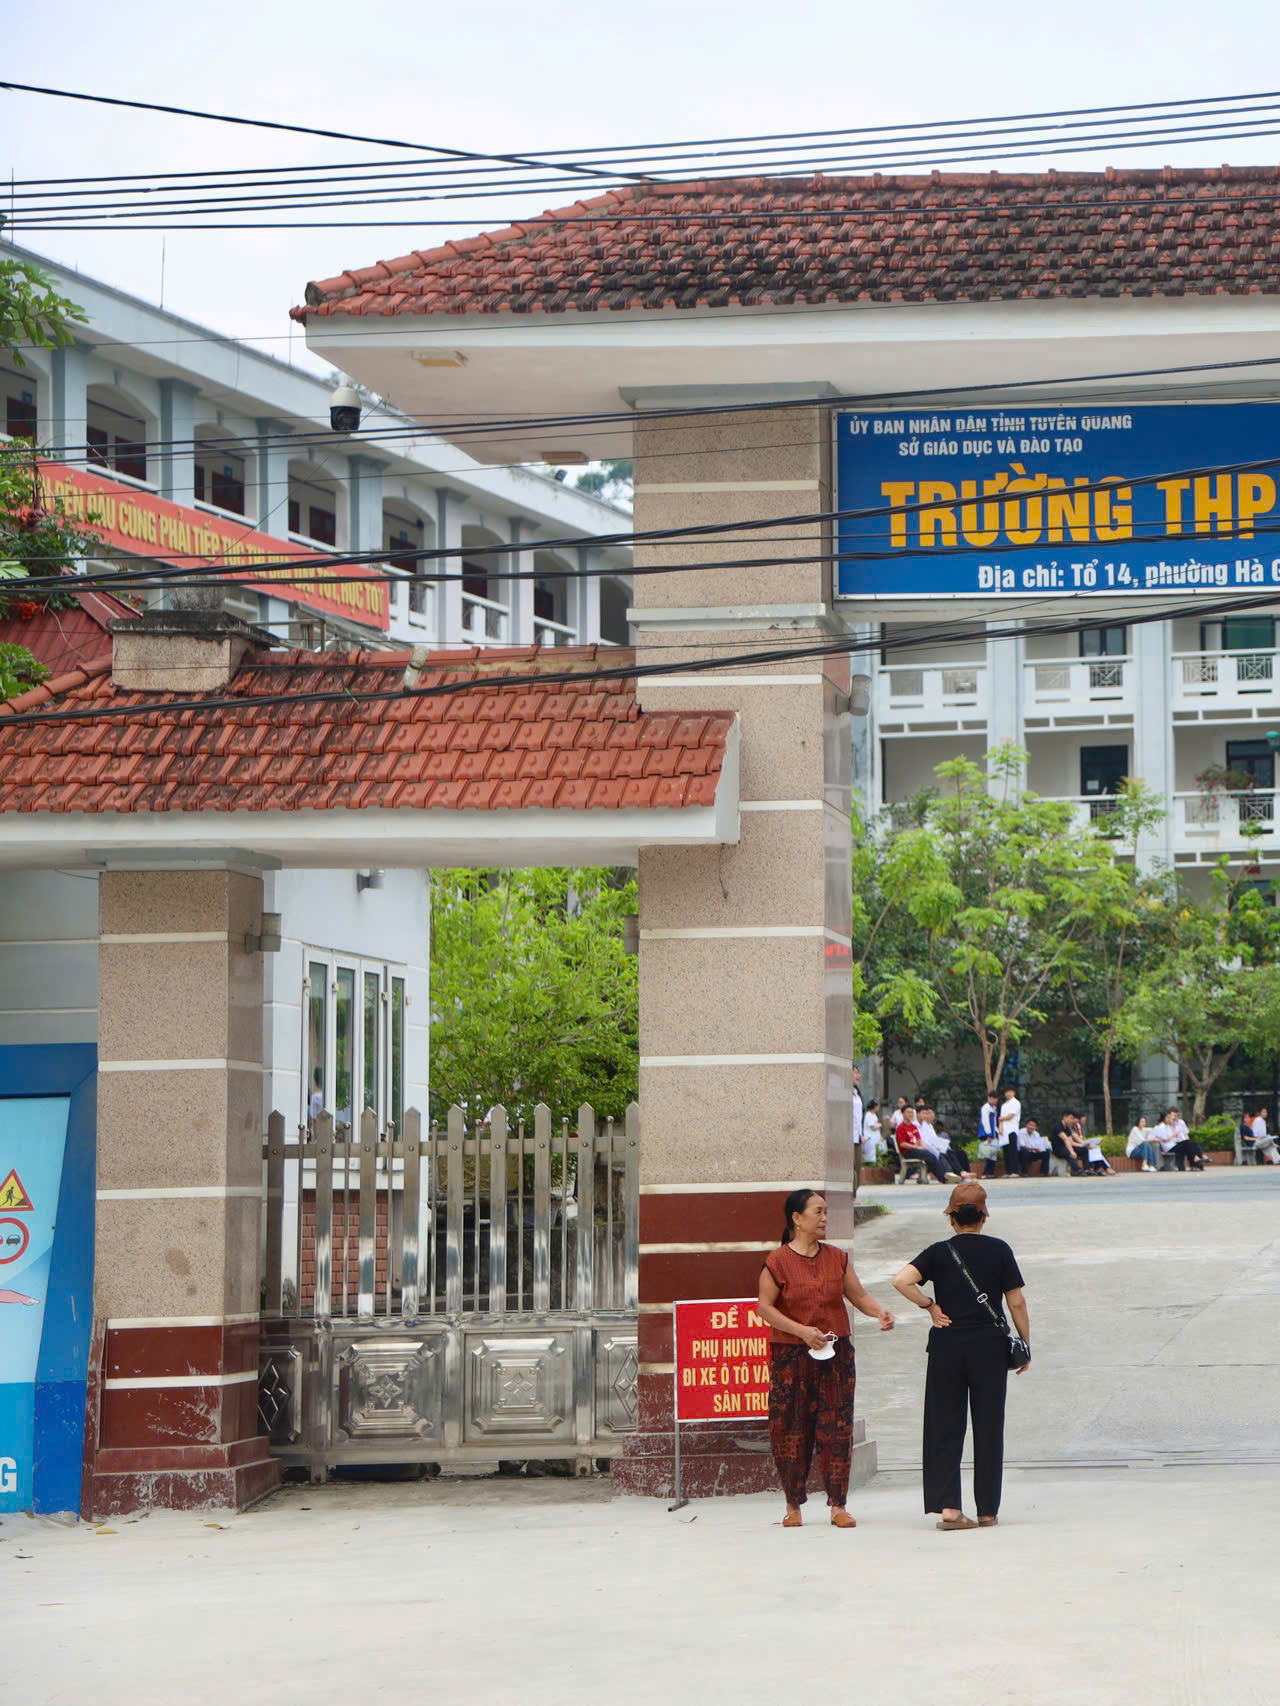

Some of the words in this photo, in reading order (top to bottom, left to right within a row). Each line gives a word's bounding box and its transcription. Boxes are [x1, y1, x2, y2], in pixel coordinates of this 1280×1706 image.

[850, 415, 869, 435] ỦY
[874, 418, 901, 434] BAN
[909, 416, 950, 434] NHÂN
[956, 415, 987, 433] DÂN
[991, 412, 1025, 432] TỈNH
[1031, 413, 1077, 432] TUYÊN
[1081, 414, 1132, 432] QUANG
[899, 439, 919, 456] SỞ
[923, 438, 958, 456] GIÁO
[963, 439, 993, 458] DỤC
[997, 436, 1016, 454] VÀ
[1020, 436, 1050, 454] ĐÀO
[1055, 438, 1083, 456] TẠO
[881, 462, 1134, 548] TRƯỜNG
[118, 498, 156, 545] CŨNG
[159, 508, 192, 556] PHẢI
[978, 564, 1016, 593] Địa
[1022, 561, 1065, 588] chỉ:
[1071, 558, 1099, 588] Tổ
[1105, 562, 1139, 588] 14,
[1145, 558, 1228, 588] phường
[1235, 558, 1264, 583] Hà
[710, 1305, 739, 1329] ĐỀ
[692, 1340, 718, 1362] PHỤ
[723, 1337, 767, 1357] HUYNH
[682, 1368, 696, 1386] ĐI
[700, 1367, 717, 1385] XE
[721, 1362, 729, 1385] Ô
[733, 1360, 749, 1384] TÔ
[753, 1361, 770, 1384] VÀ
[714, 1390, 741, 1412] SÂN
